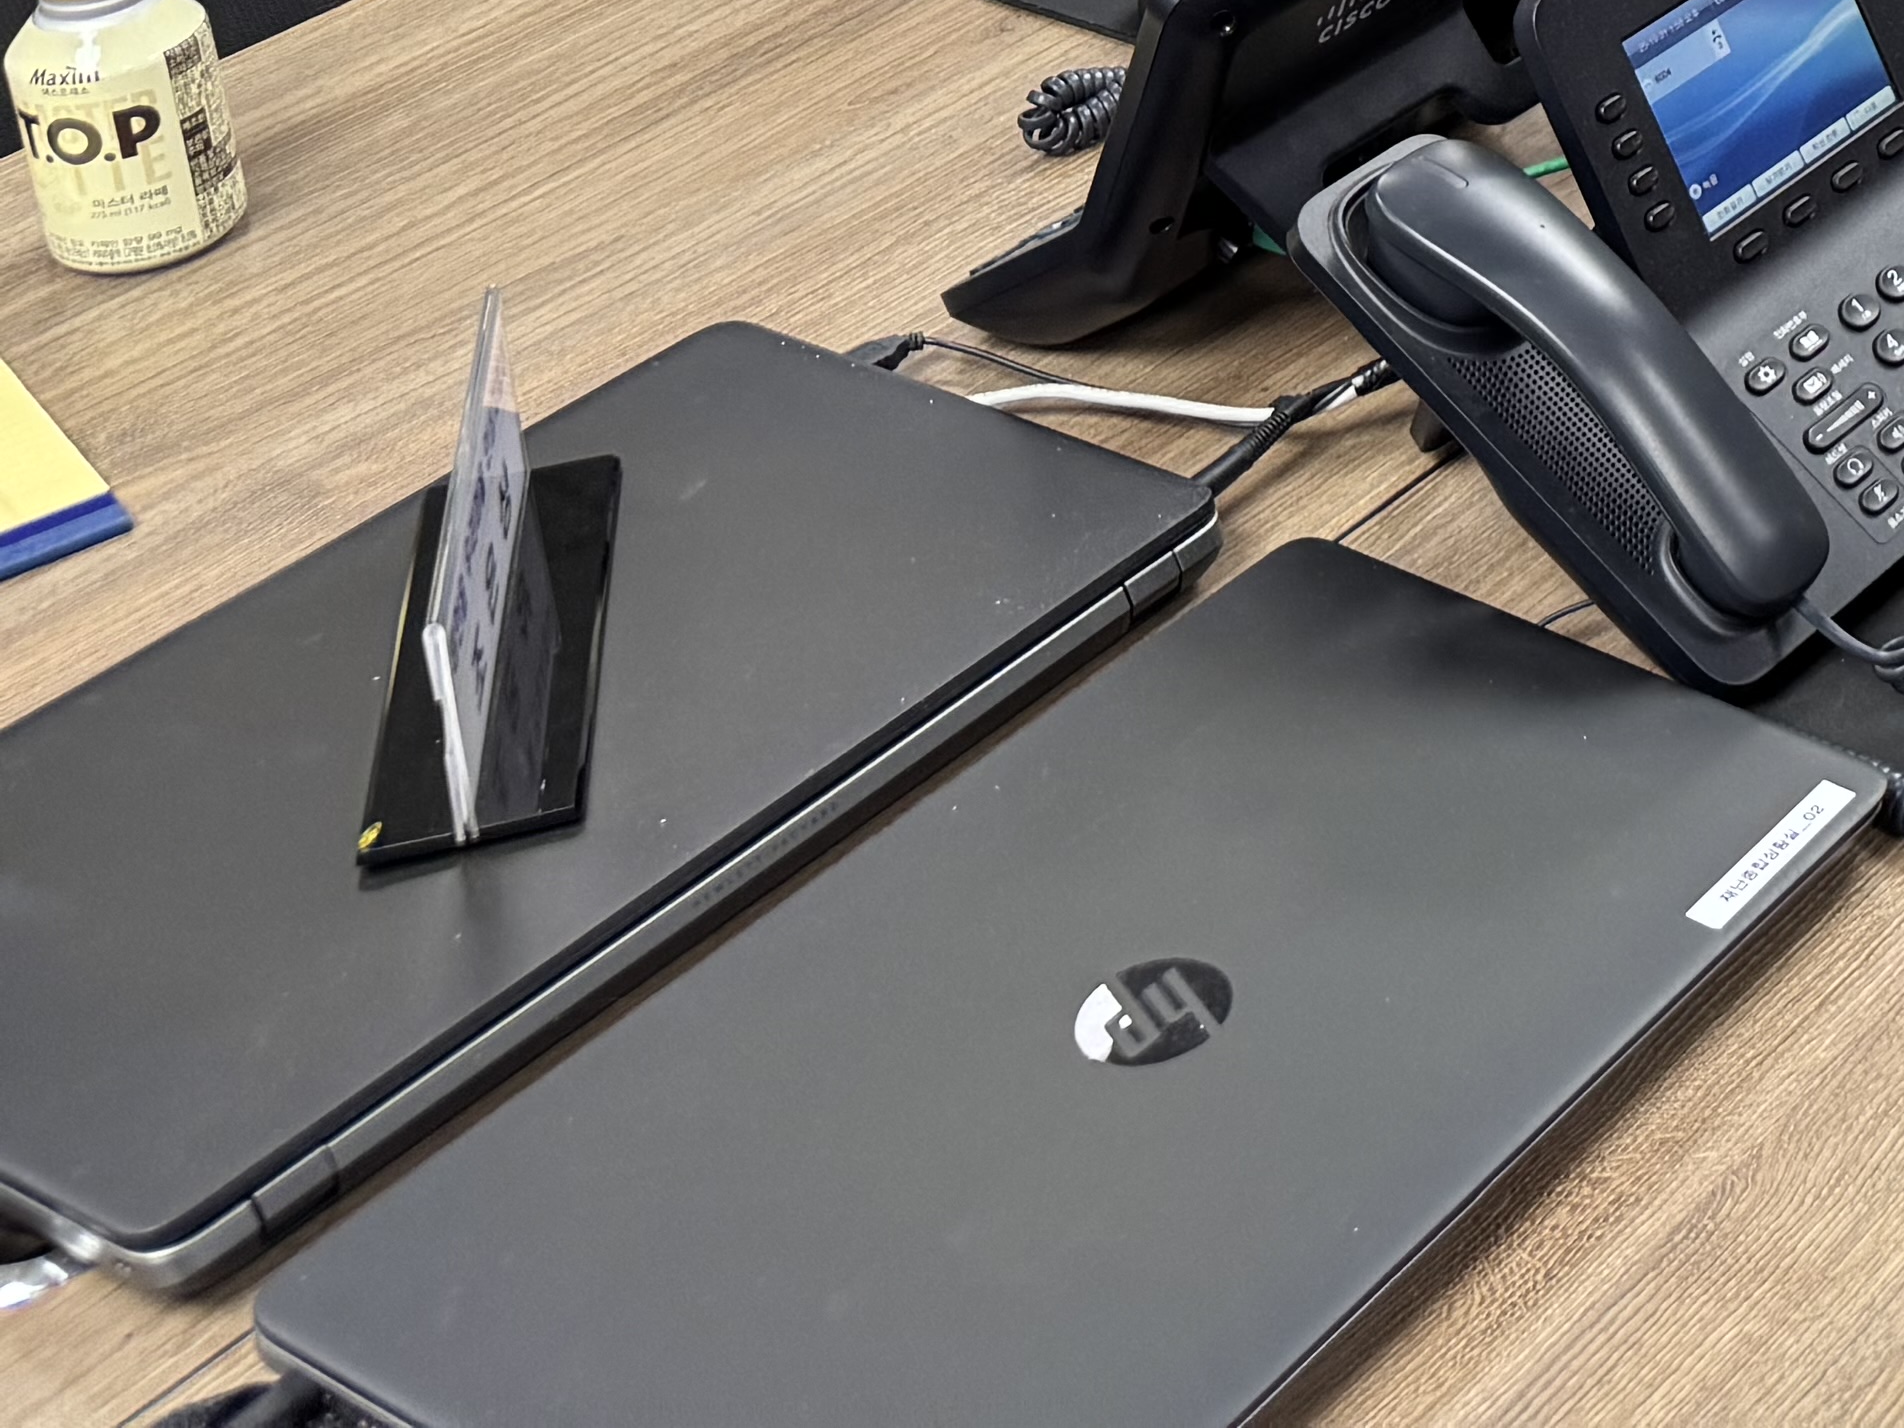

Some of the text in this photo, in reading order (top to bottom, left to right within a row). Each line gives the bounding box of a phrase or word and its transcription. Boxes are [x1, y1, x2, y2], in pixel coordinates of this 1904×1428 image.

[29, 66, 100, 87] Maxim
[18, 105, 161, 165] T.O.P
[92, 195, 135, 209] 마스터
[1887, 270, 1901, 287] 2
[1885, 334, 1899, 351] 4
[1090, 959, 1229, 1065] hp
